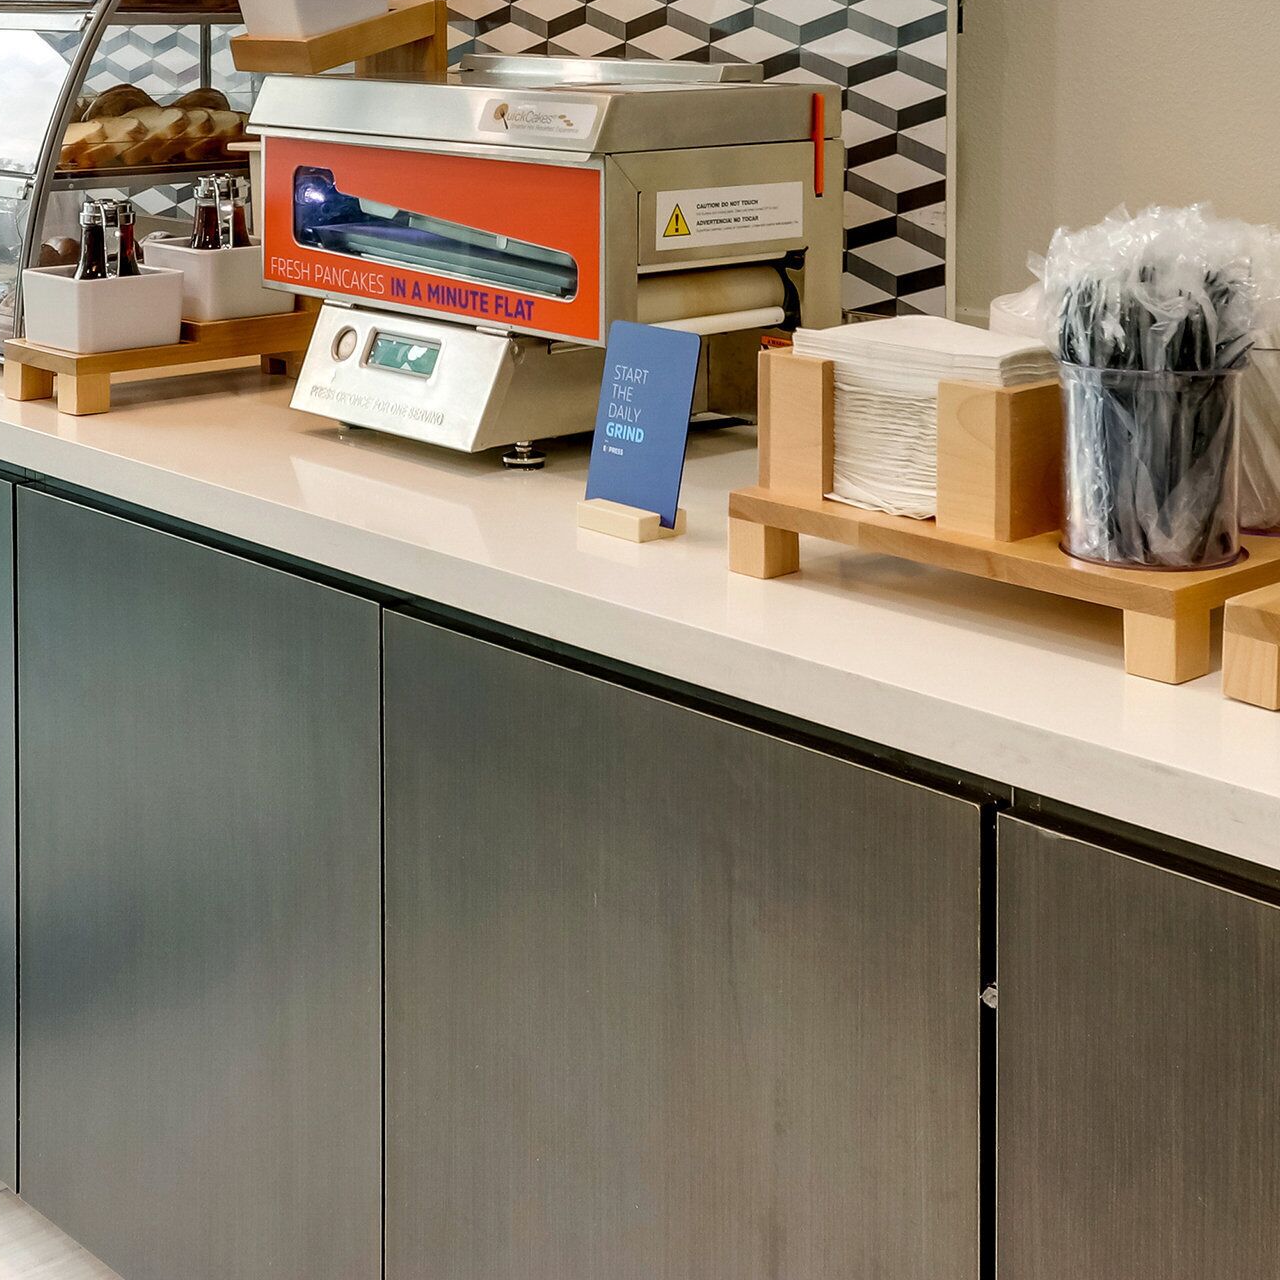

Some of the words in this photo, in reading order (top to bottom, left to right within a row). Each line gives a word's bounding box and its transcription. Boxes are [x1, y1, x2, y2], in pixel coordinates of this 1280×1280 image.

[271, 256, 310, 281] FRESH
[314, 264, 385, 295] PANCAKES
[391, 277, 406, 298] IN
[411, 281, 423, 301] A
[427, 283, 489, 313] MINUTE
[494, 295, 535, 321] FLAT
[614, 364, 649, 384] START
[612, 383, 634, 402] THE
[608, 402, 641, 423] DAILY
[606, 422, 644, 443] GRIND
[603, 445, 624, 456] EPRESS
